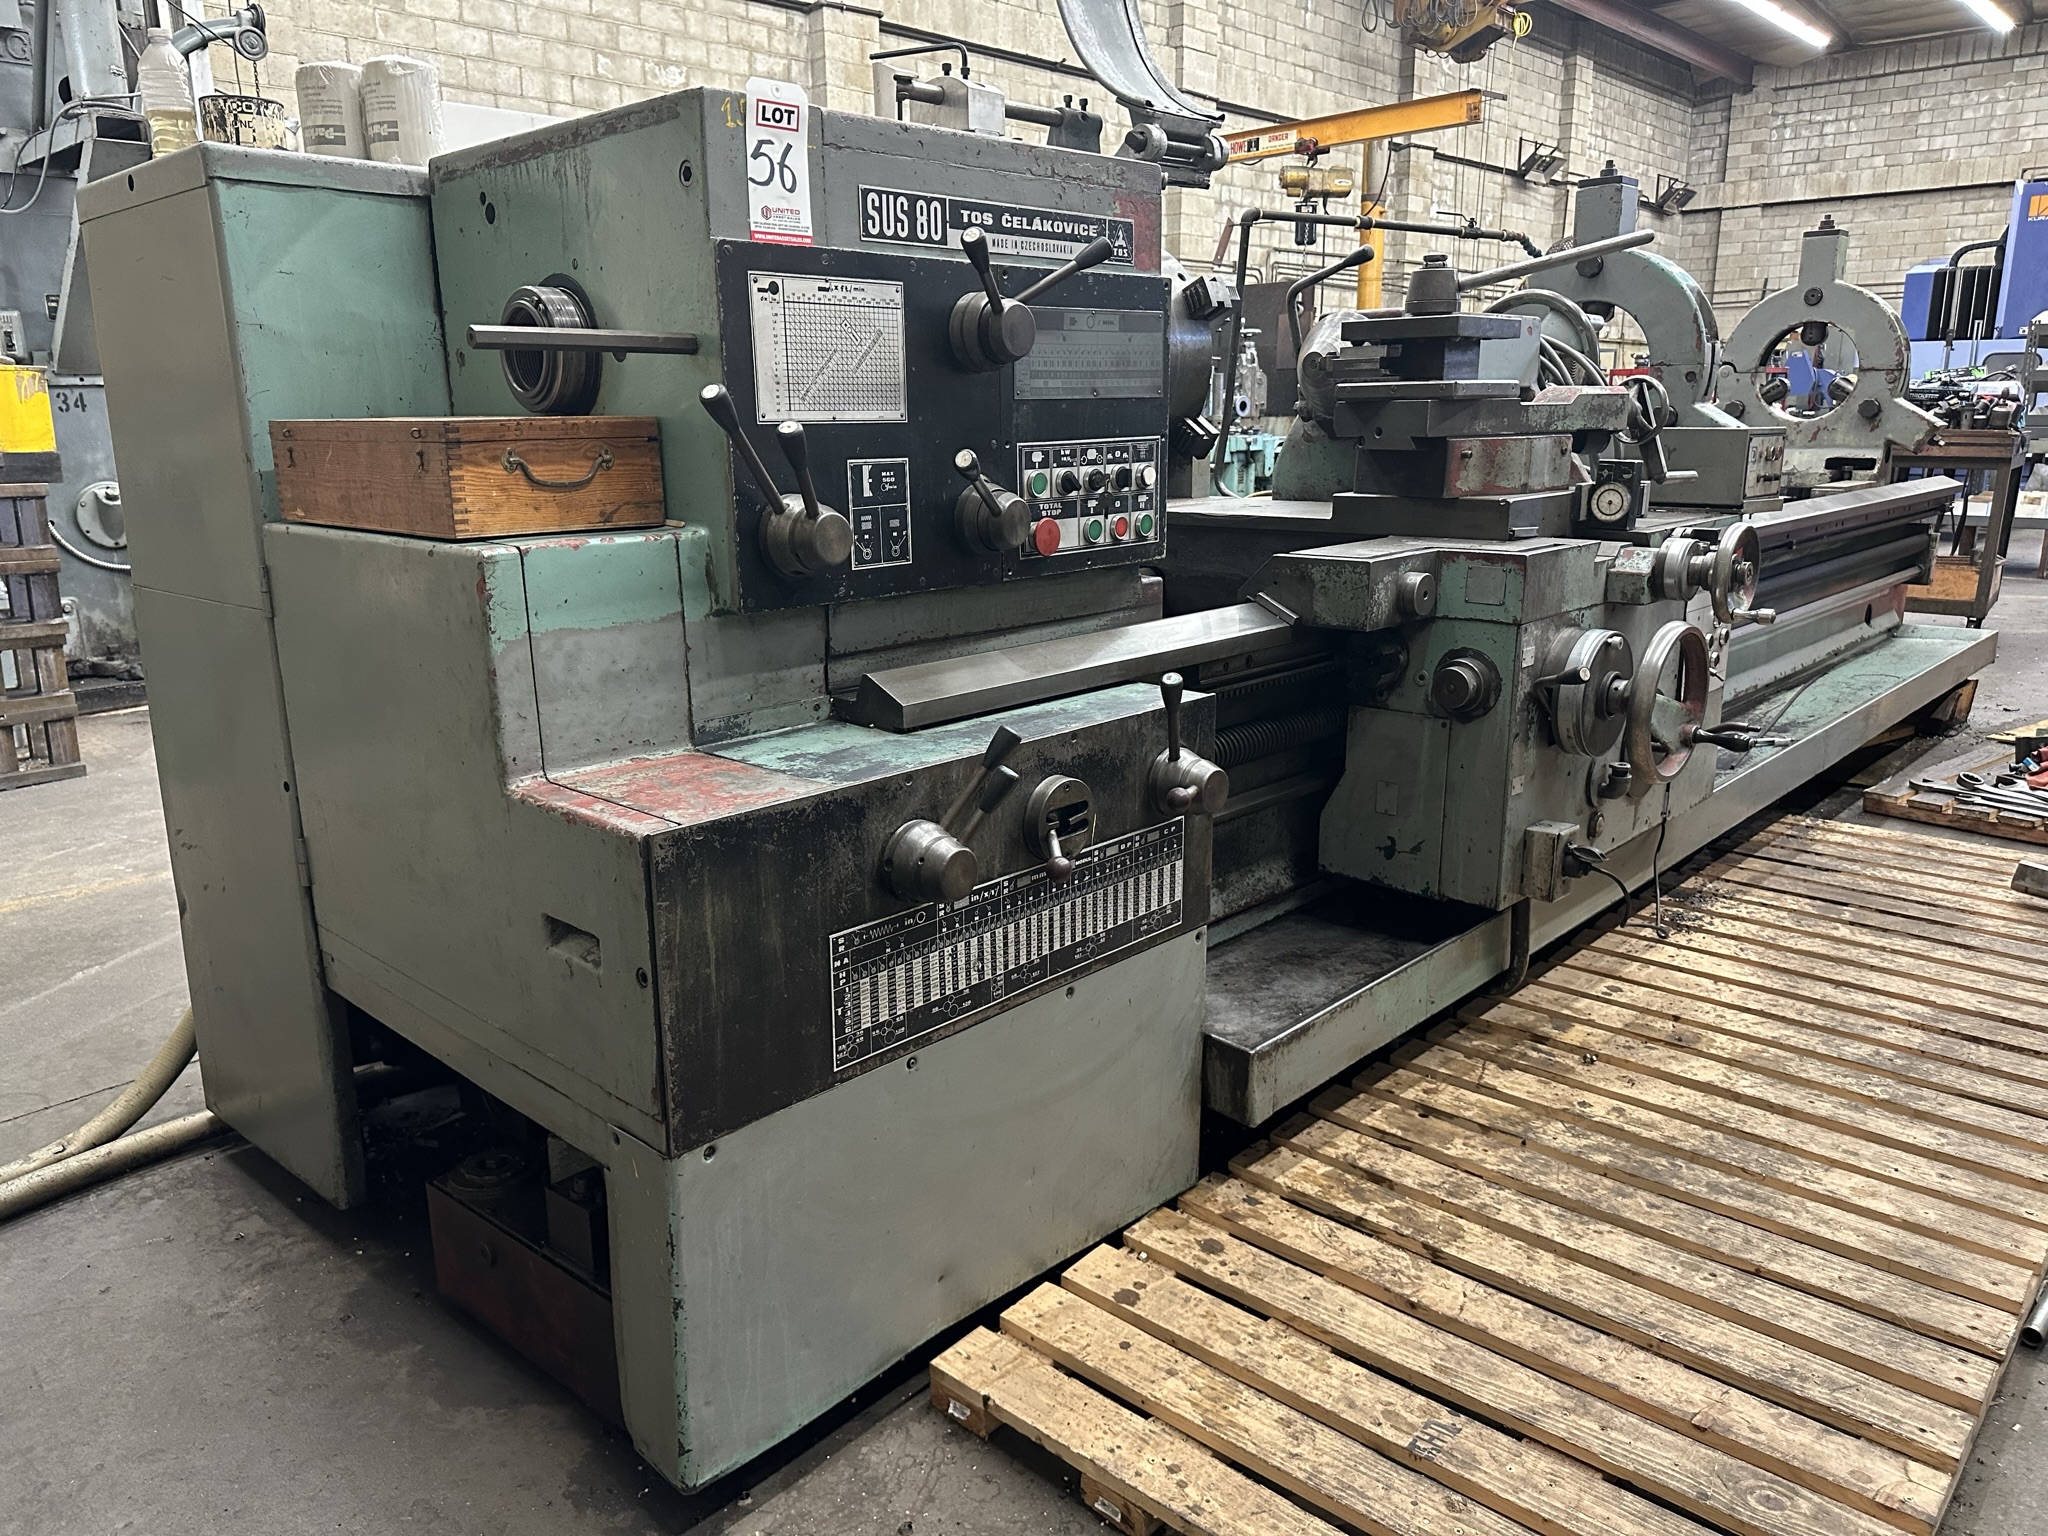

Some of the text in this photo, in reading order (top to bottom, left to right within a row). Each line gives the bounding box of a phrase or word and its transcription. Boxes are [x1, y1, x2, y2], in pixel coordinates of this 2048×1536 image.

[761, 105, 795, 126] LOT
[1268, 132, 1289, 143] DANGER
[1230, 140, 1247, 155] HOWE
[748, 139, 797, 194] 56
[772, 207, 800, 216] UNITED
[866, 191, 942, 241] SUS 80
[960, 204, 1099, 237] TOS ČELÁKOVICE
[992, 238, 1073, 254] MADE IN CZECHOSLOVAKIA
[1113, 248, 1128, 257] TOS
[56, 392, 87, 412] 34
[836, 1007, 844, 1016] T
